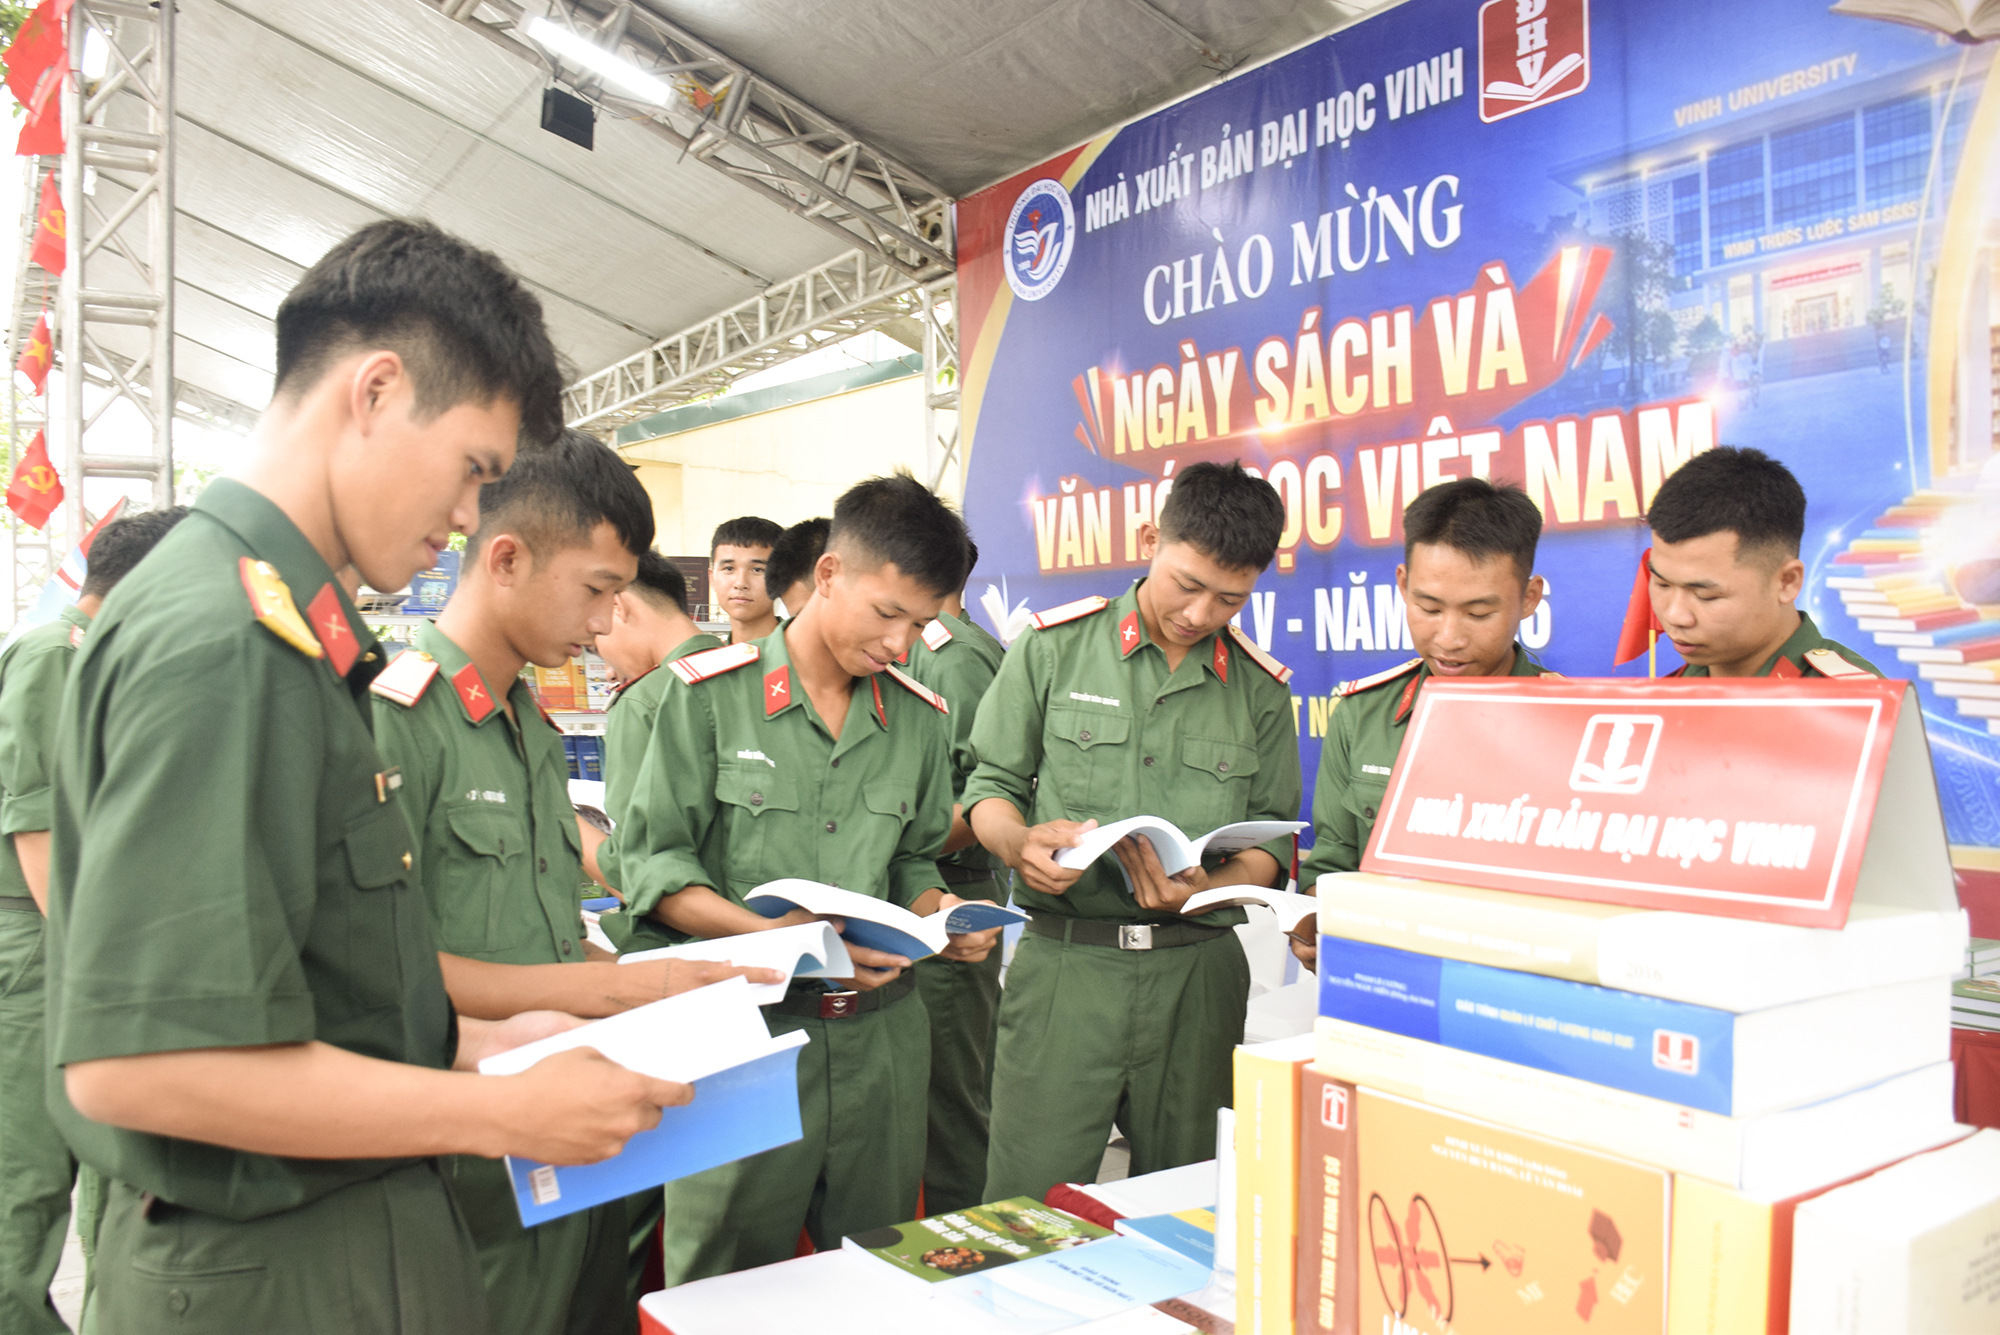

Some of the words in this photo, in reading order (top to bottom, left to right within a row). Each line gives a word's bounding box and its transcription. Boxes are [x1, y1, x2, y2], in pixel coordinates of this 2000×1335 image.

[1674, 96, 1722, 128] VINH
[1728, 52, 1858, 111] UNIVERSITY
[1086, 172, 1130, 233] NHÀ
[1135, 142, 1195, 215] XUẤT
[1201, 123, 1254, 190] BẢN
[1261, 108, 1307, 169] ĐẠI
[1316, 83, 1376, 149] HỌC
[1385, 47, 1463, 121] VINH
[1143, 227, 1274, 325] CHÀO
[1290, 174, 1464, 287] MỪNG
[1114, 343, 1239, 455] NGÀY
[1254, 311, 1413, 428] SÁCH
[1432, 266, 1528, 396] VÀ
[1033, 478, 1112, 570] VĂN
[1523, 401, 1714, 524] NAM
[1406, 793, 1464, 837] NHÀ
[1462, 793, 1540, 845] XUẤT
[1535, 797, 1602, 851] BẢN
[1600, 812, 1658, 863] ĐẠI
[1657, 816, 1728, 869] HỌC
[1731, 820, 1816, 870] VINH
[1626, 961, 1664, 982] 2016
[1322, 1196, 1339, 1232] KHOA
[1318, 1297, 1335, 1330] GIÁO
[1319, 1257, 1337, 1298] TRÌNH
